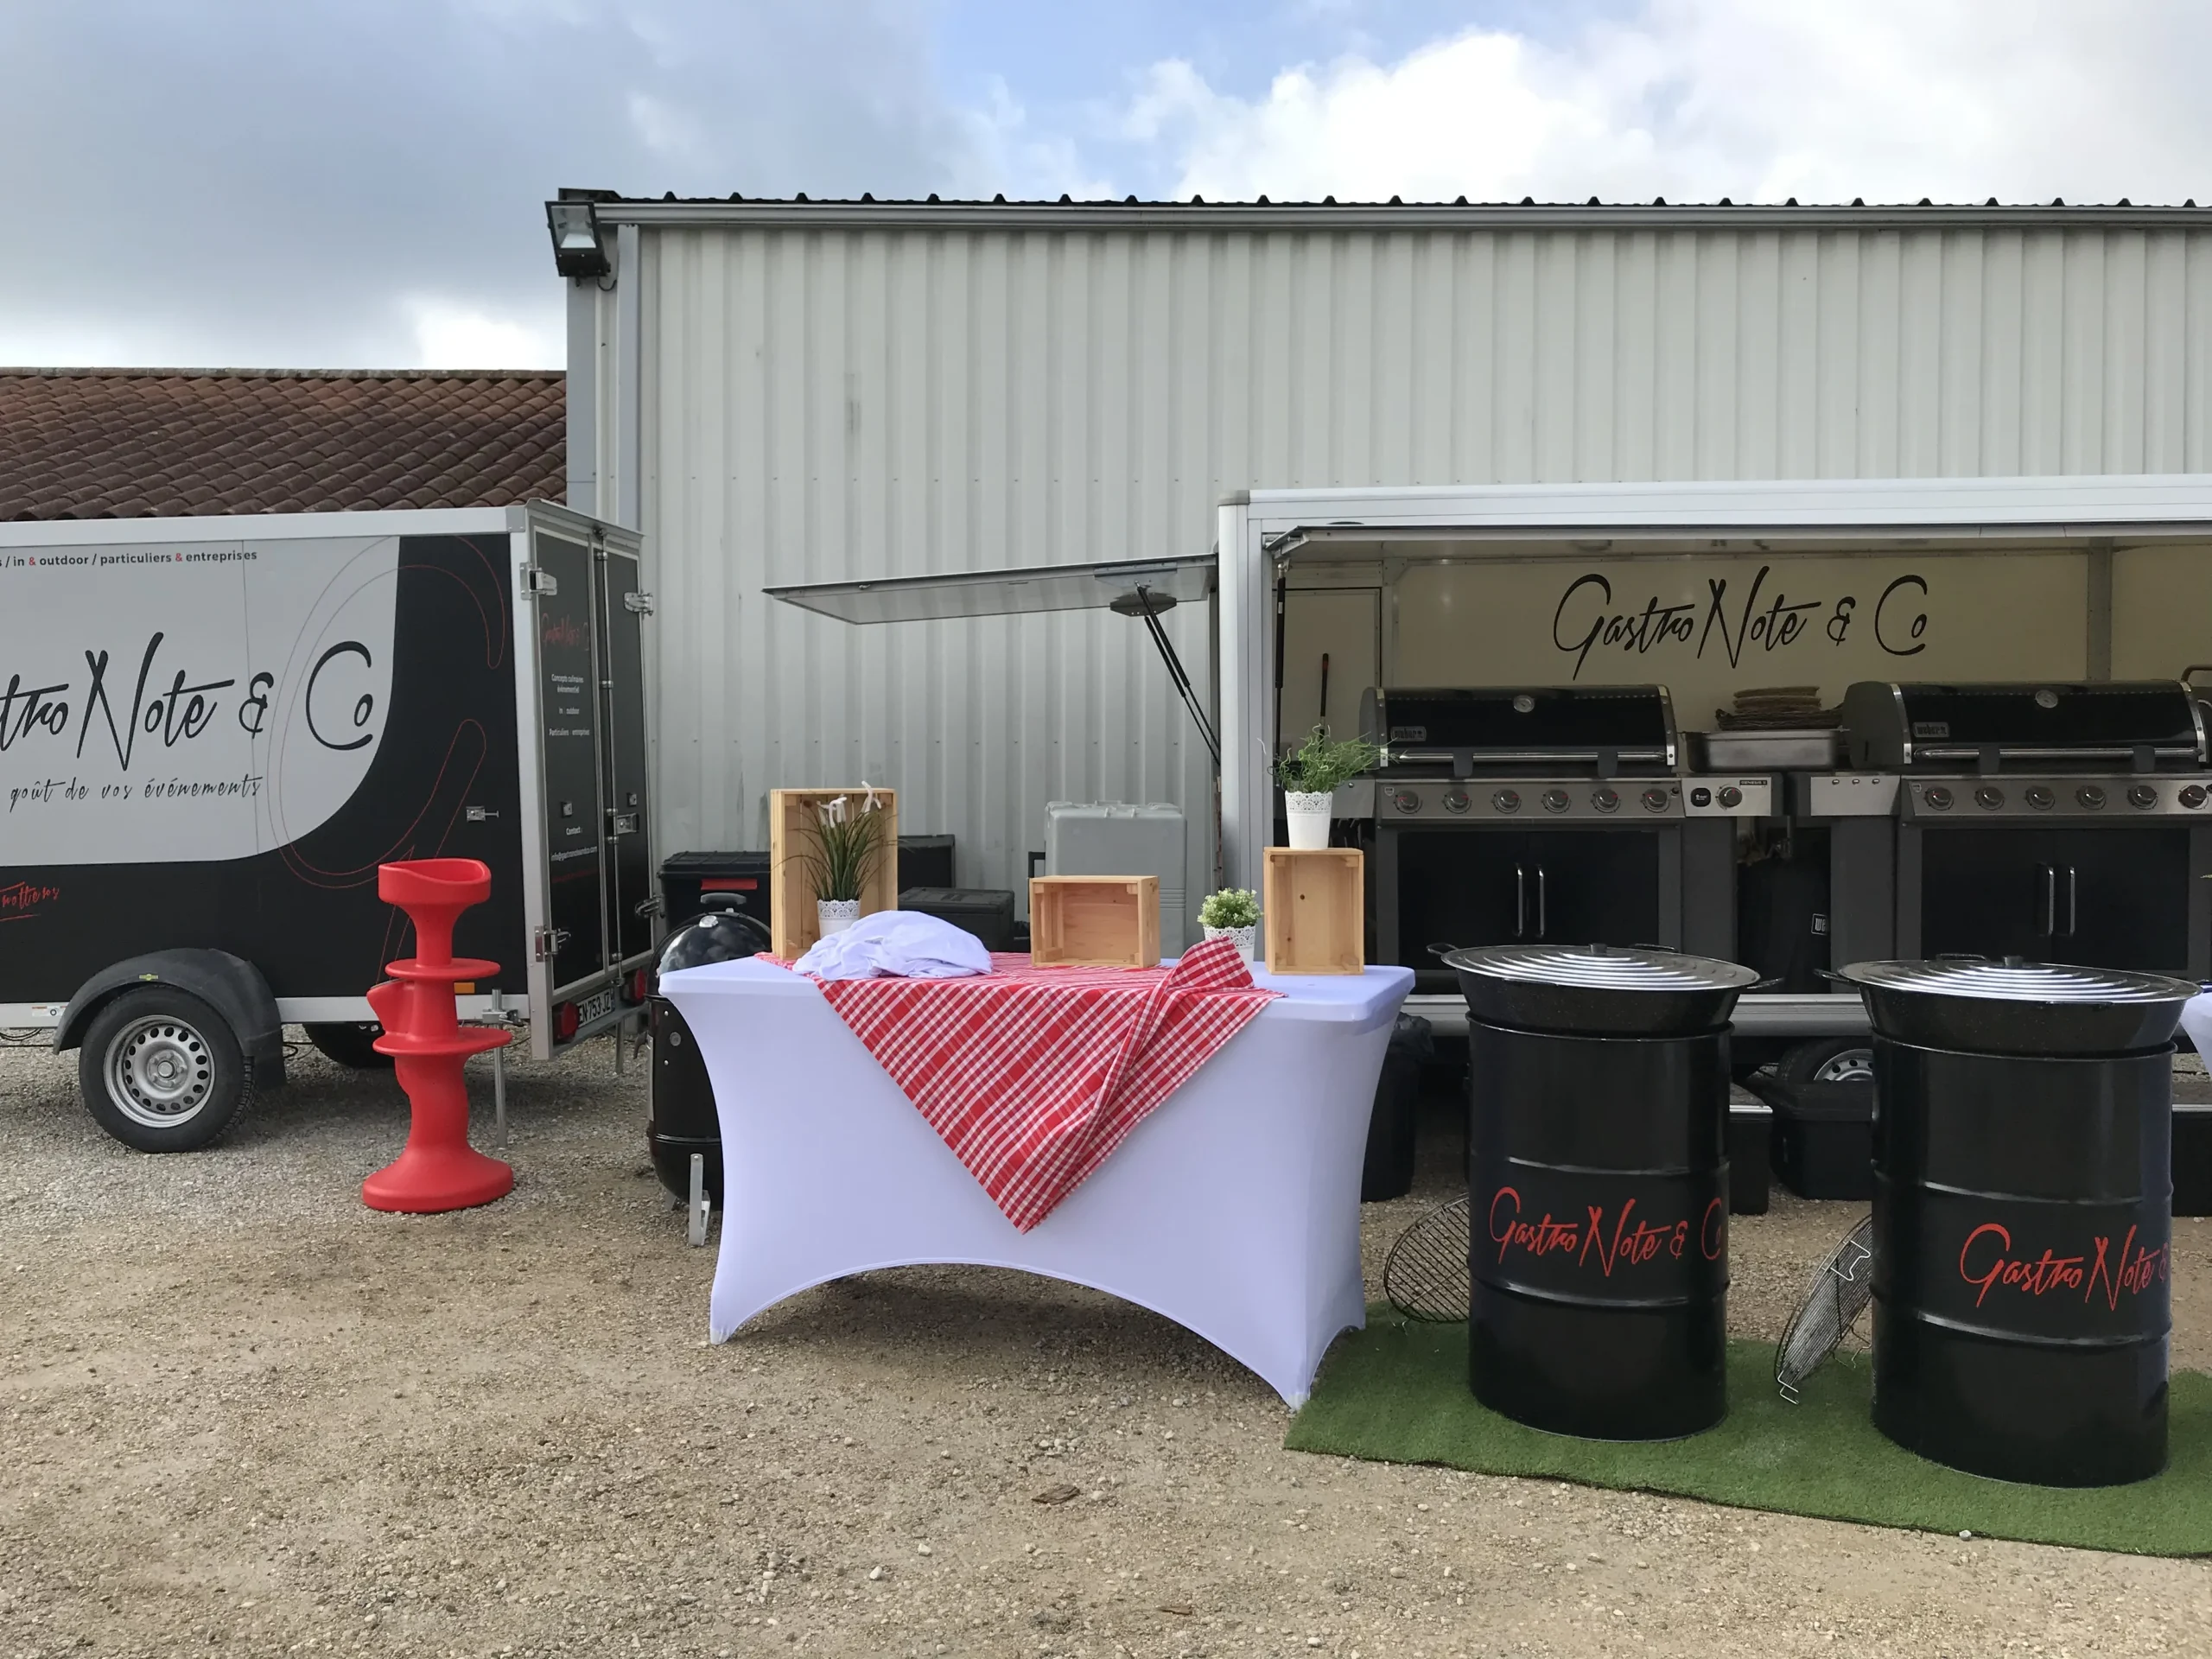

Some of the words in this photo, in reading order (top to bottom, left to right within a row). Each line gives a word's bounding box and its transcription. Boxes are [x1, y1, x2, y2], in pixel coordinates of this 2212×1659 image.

[13, 556, 25, 567] in
[29, 556, 36, 566] &
[40, 554, 89, 567] outdoor
[100, 552, 172, 566] particuliers
[175, 552, 182, 563] &
[186, 550, 257, 563] entreprises
[1554, 574, 1695, 681] Gastro
[1697, 565, 1821, 669] Note
[1827, 595, 1856, 646] &
[1875, 574, 1928, 656] Co
[0, 674, 69, 752] tro
[76, 632, 235, 771] Note
[238, 671, 274, 739] &
[306, 640, 373, 751] Co
[10, 779, 66, 813] goût
[65, 776, 89, 801] de
[101, 781, 132, 801] vos
[144, 775, 263, 800] événements
[1489, 1186, 1579, 1265] Gastro
[1580, 1198, 1673, 1277] Note
[1669, 1220, 1688, 1259] &
[1960, 1223, 2084, 1308] Gastro
[2085, 1224, 2160, 1312] Note
